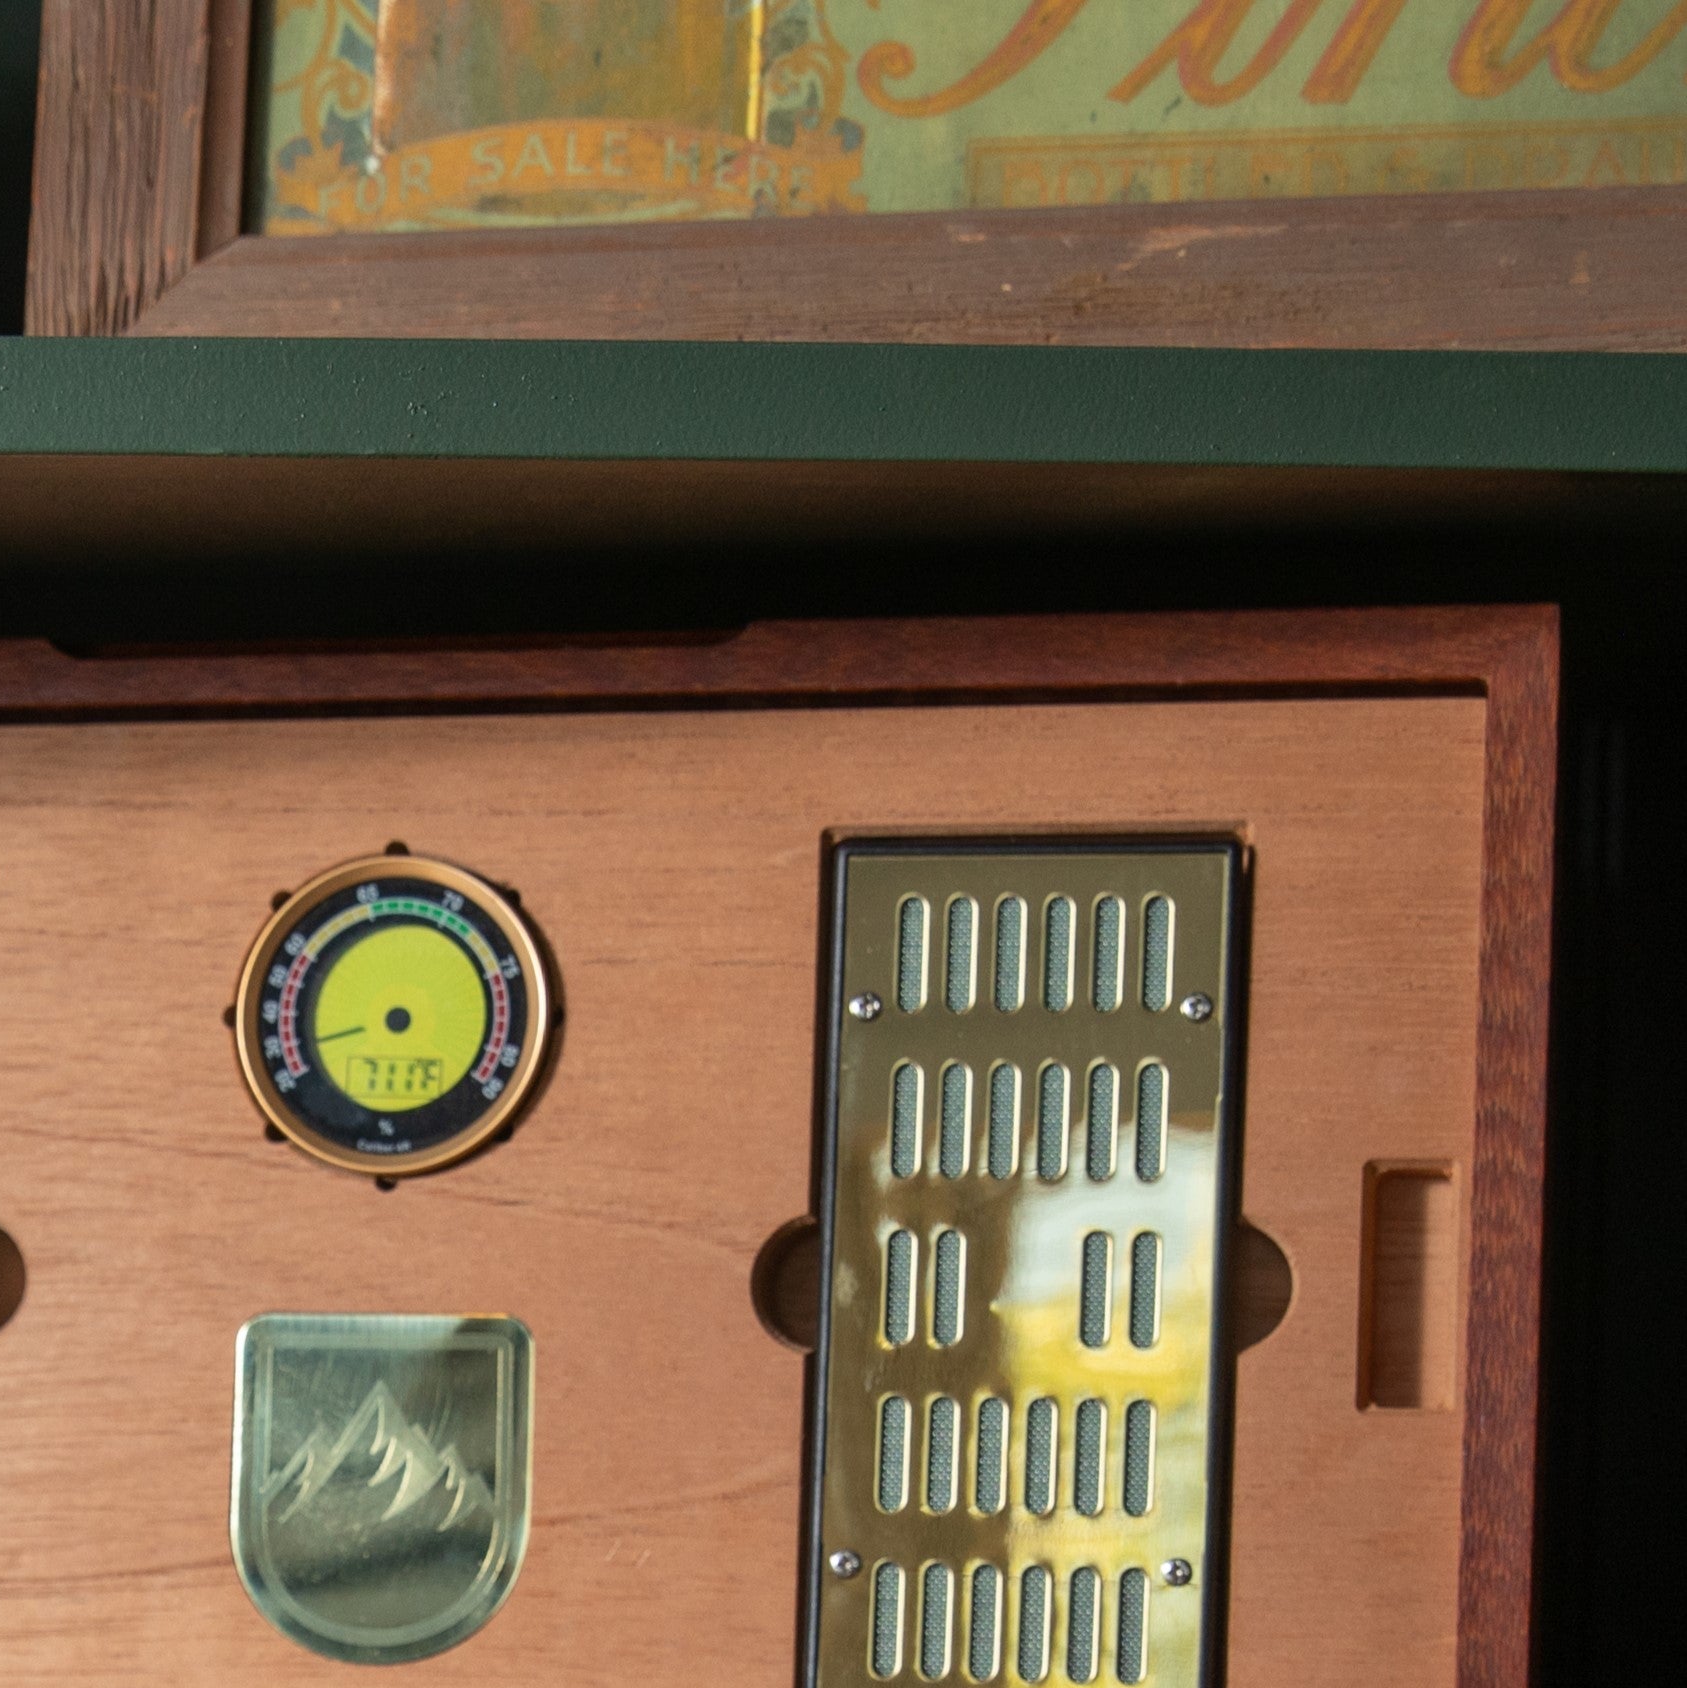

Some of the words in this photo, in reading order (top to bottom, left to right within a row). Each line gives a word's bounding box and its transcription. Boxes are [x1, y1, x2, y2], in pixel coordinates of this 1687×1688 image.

[316, 157, 435, 218] FOR
[470, 129, 632, 187] SALE
[663, 135, 813, 210] HERE
[441, 890, 464, 912] 70
[284, 932, 306, 956] 60
